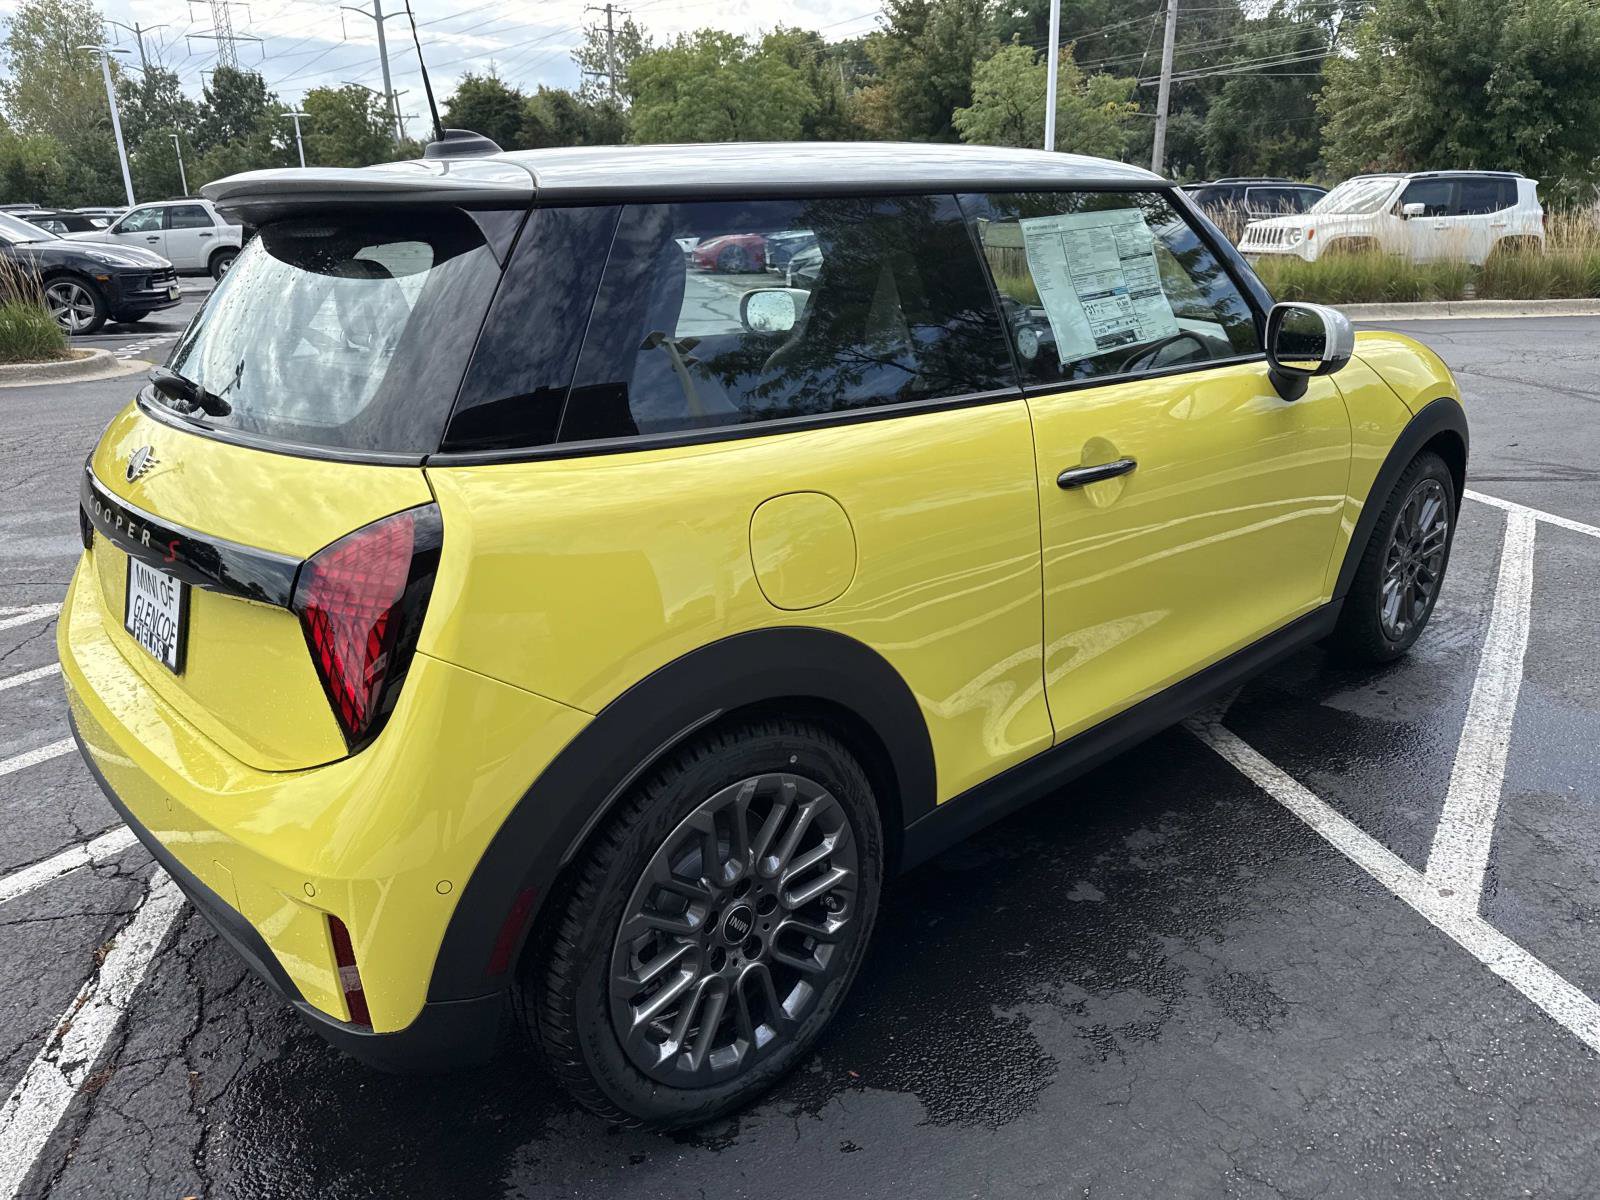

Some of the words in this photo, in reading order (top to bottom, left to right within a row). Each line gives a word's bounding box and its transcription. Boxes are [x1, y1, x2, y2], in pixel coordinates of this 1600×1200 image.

[88, 494, 151, 548] COOPER
[162, 540, 180, 563] S
[135, 563, 159, 601] MINI
[160, 580, 174, 610] OF
[134, 594, 176, 649] GLENCOE
[135, 620, 164, 662] FIELDS
[728, 915, 749, 933] MINI
